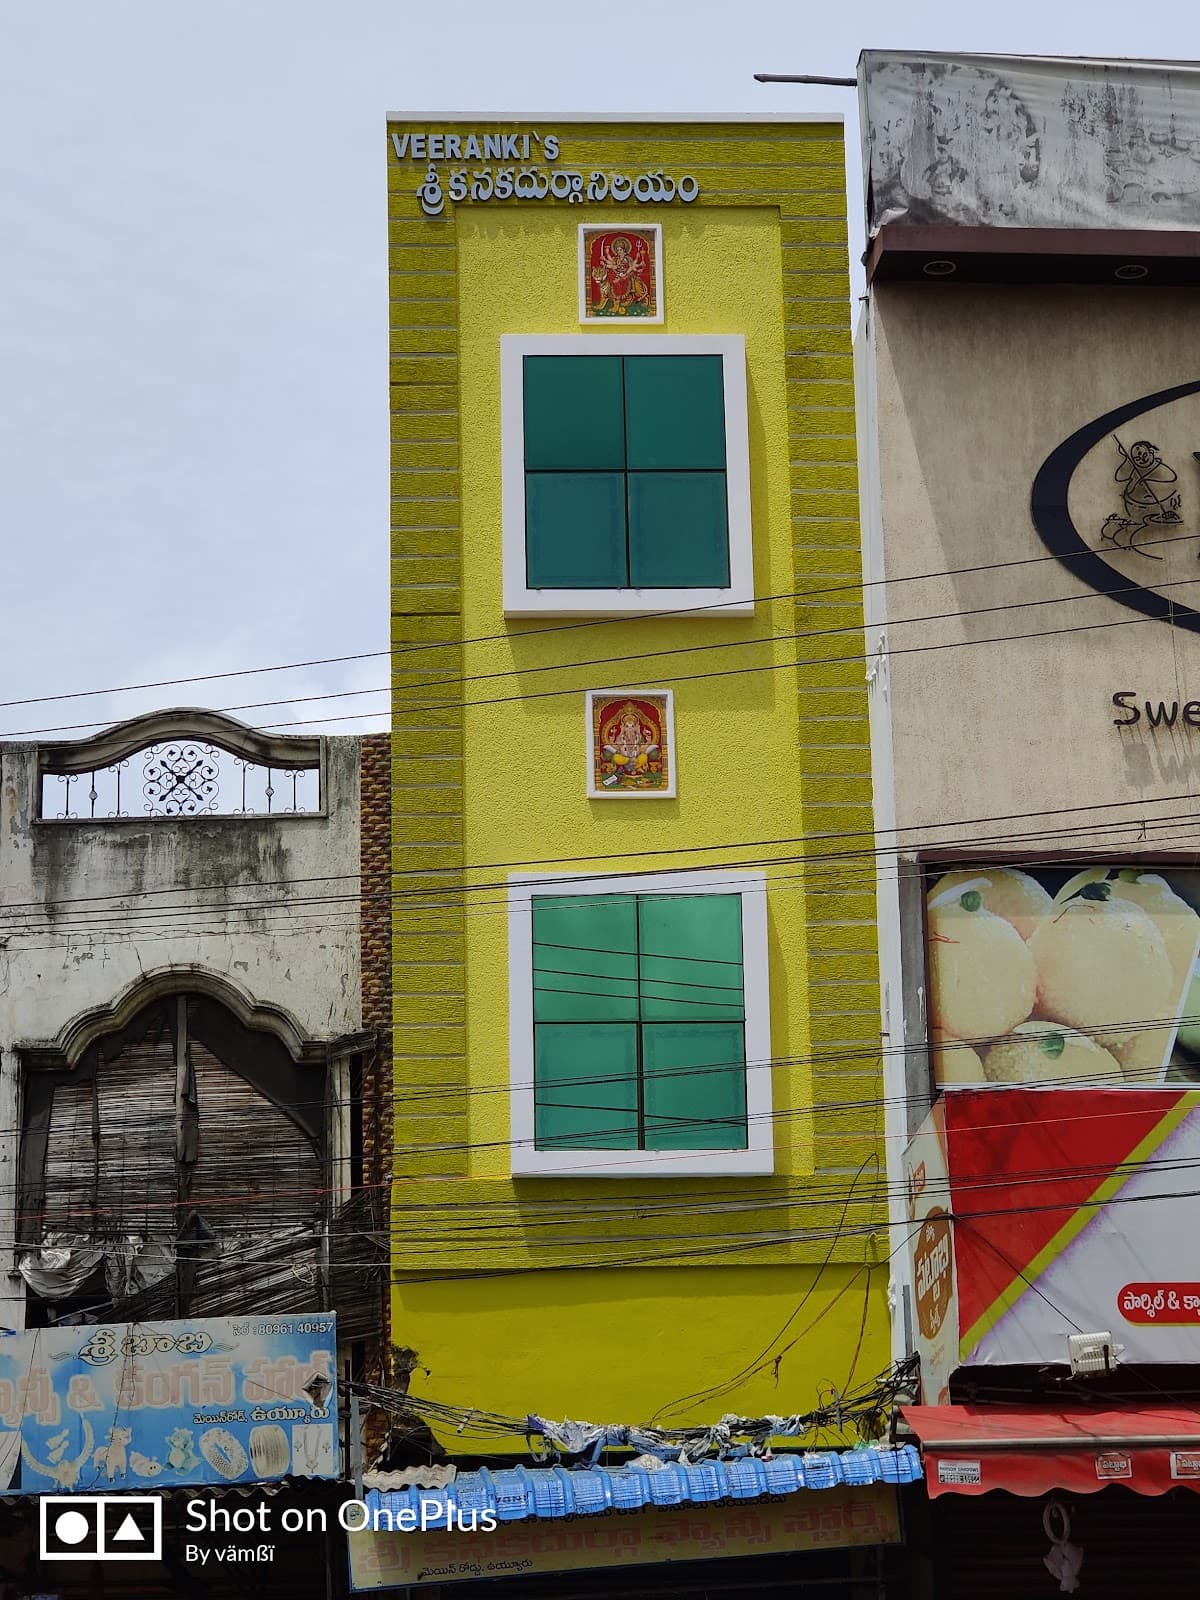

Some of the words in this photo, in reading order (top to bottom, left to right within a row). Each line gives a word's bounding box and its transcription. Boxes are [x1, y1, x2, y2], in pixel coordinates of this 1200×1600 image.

[416, 163, 445, 215] శ్రీ
[1168, 1291, 1181, 1310] &
[297, 1321, 334, 1334] 40957
[78, 1329, 118, 1366] శ్రీ
